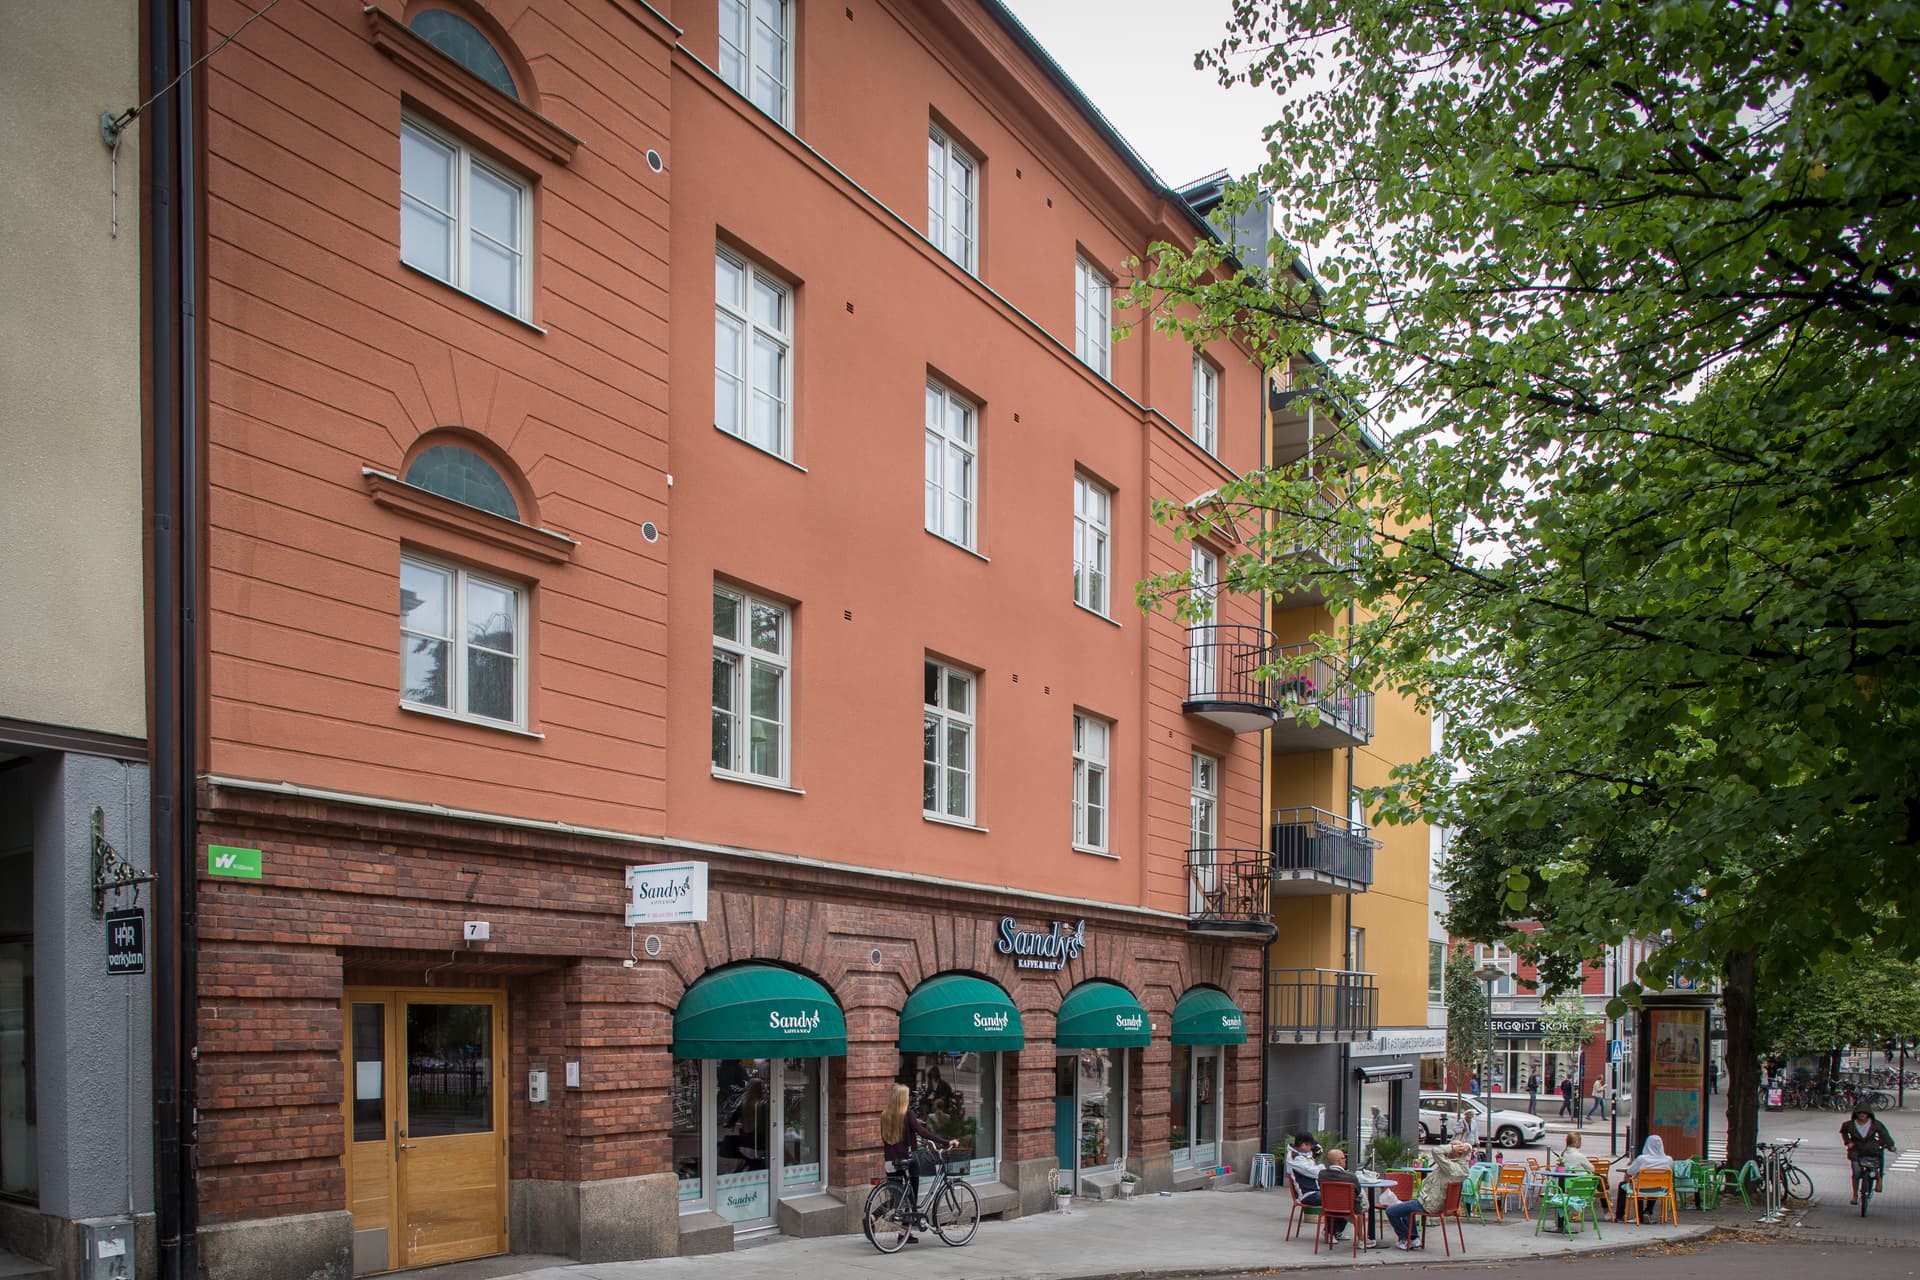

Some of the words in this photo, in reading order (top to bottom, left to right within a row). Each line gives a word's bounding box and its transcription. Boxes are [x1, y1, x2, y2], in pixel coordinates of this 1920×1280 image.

[640, 879, 686, 903] Sandys
[114, 922, 135, 947] HÅR
[470, 924, 477, 935] 7
[998, 916, 1080, 970] Sandys
[769, 1010, 818, 1033] Sandys
[973, 1012, 1008, 1031] Sandys
[1540, 1021, 1569, 1031] SKOR
[727, 1192, 756, 1206] Sandys
